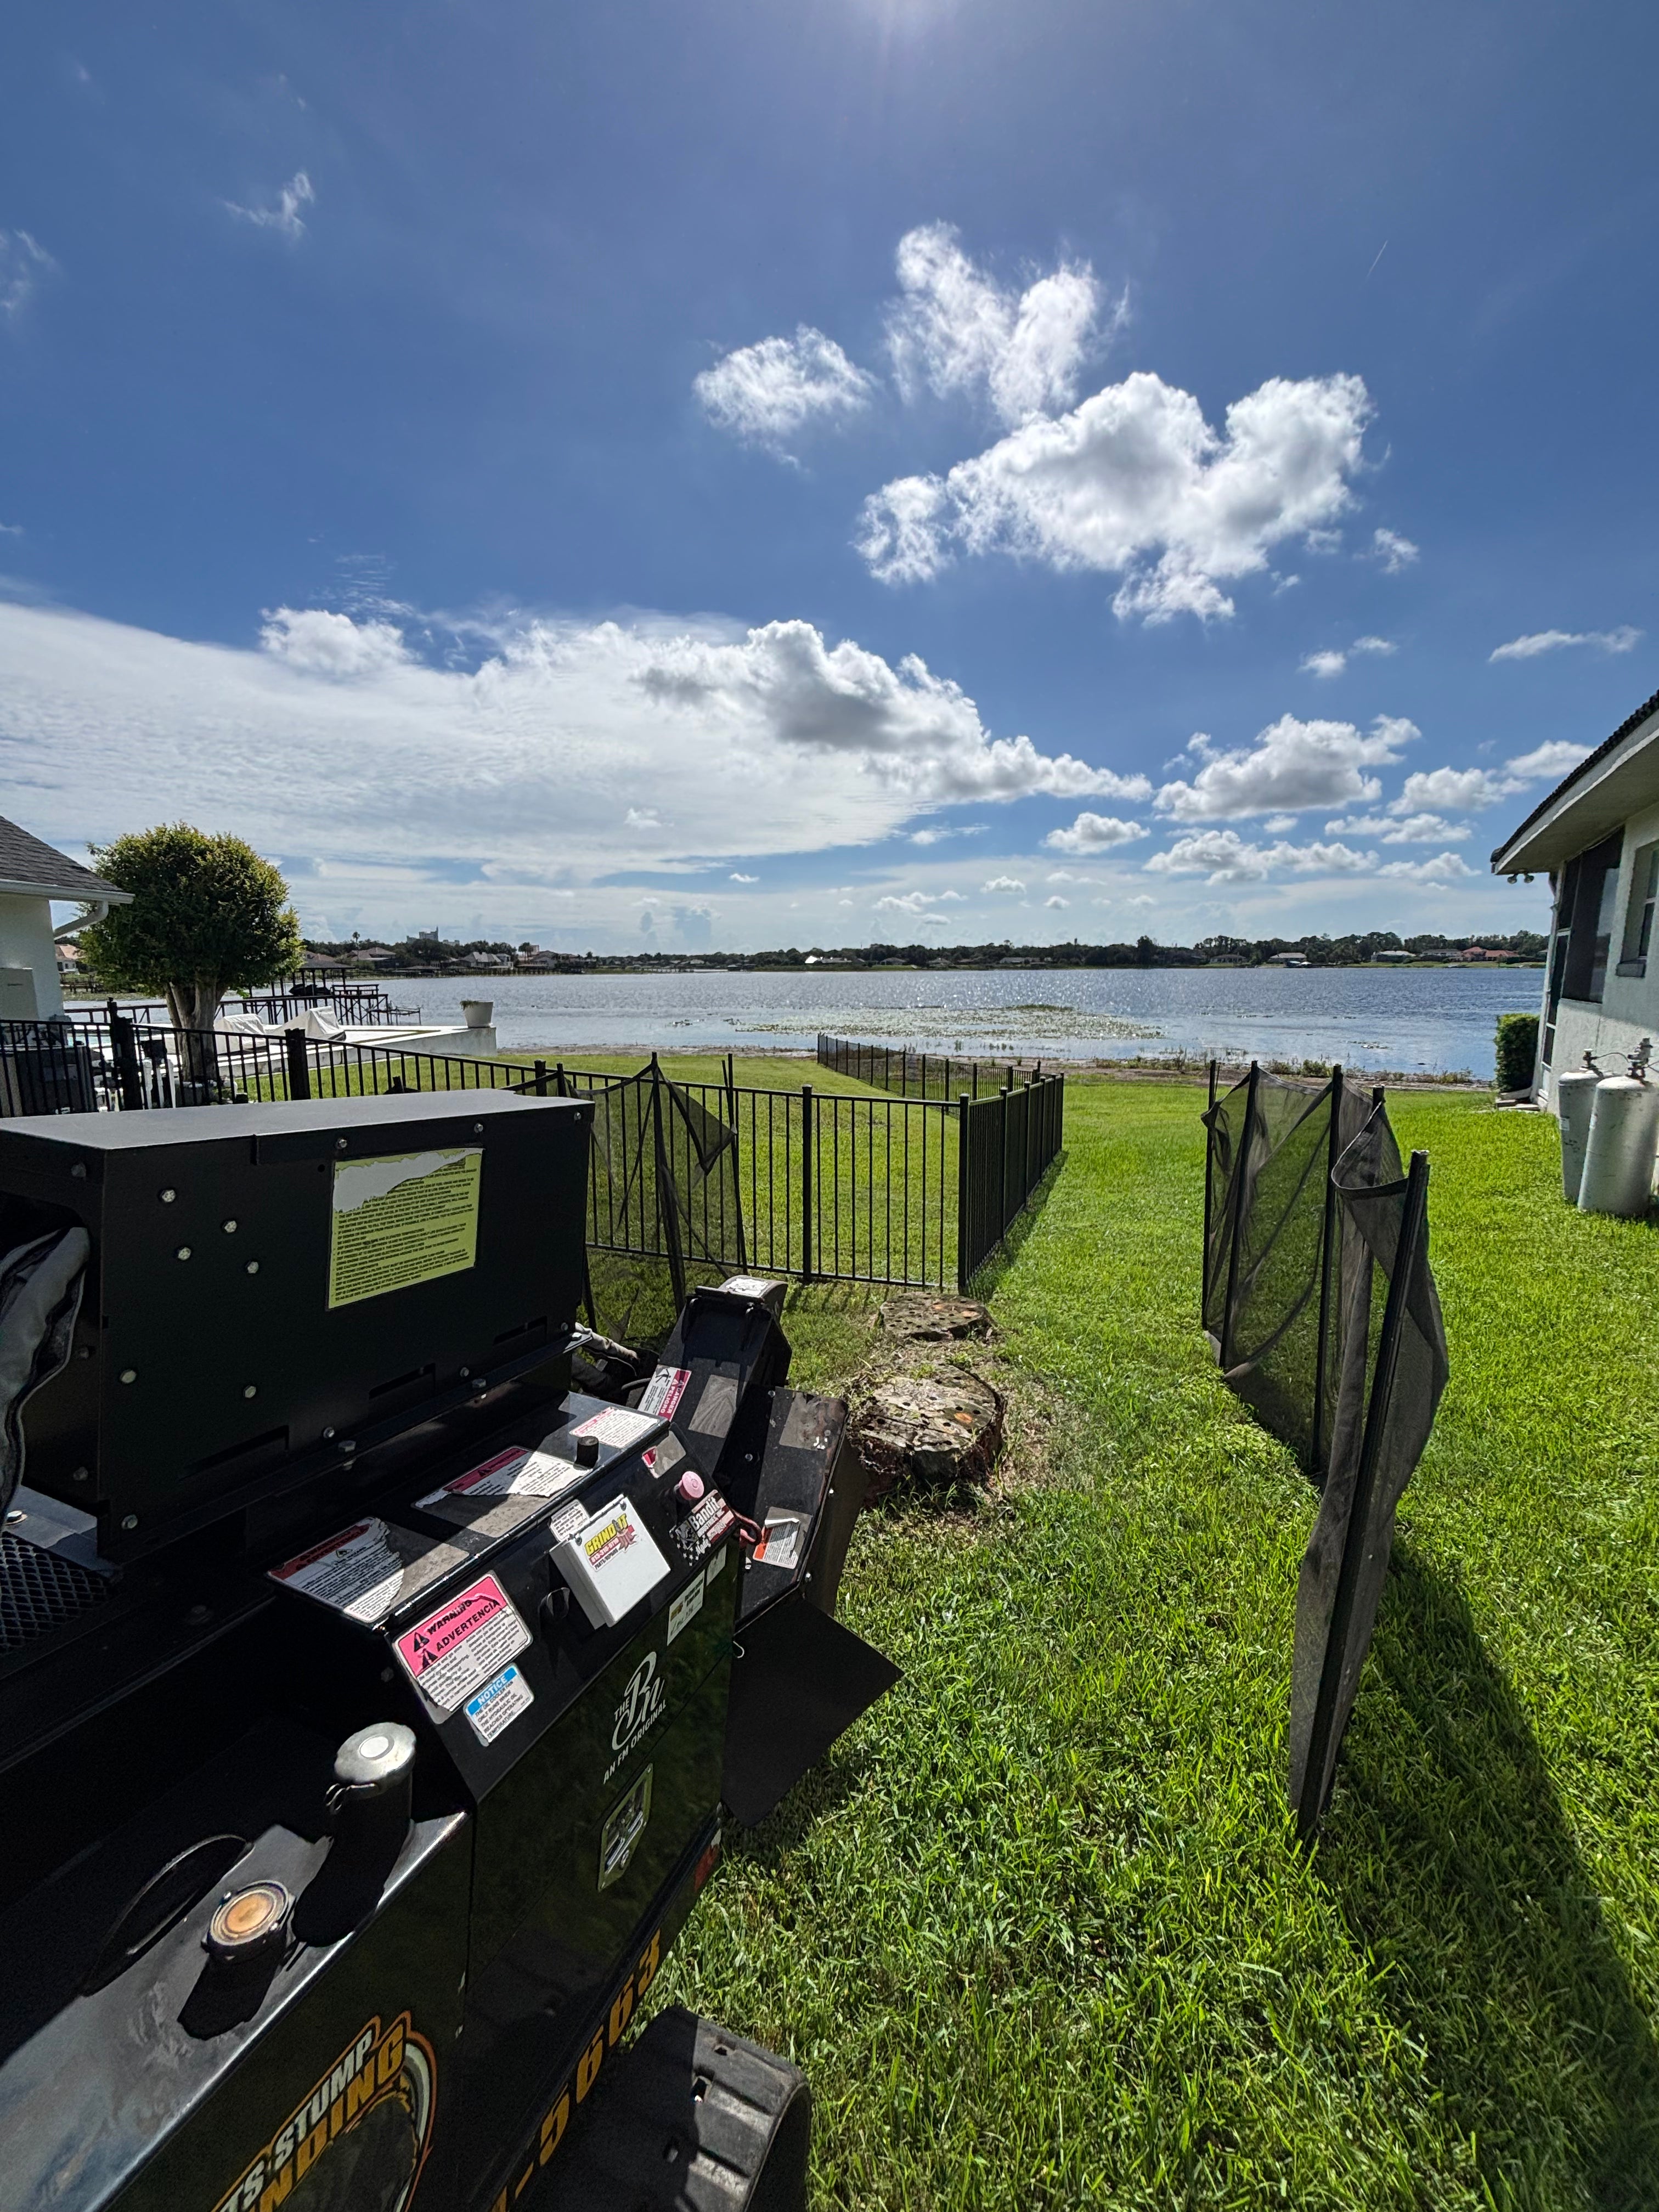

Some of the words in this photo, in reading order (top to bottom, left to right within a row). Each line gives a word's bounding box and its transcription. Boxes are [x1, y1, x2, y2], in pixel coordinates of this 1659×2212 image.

[660, 1386, 675, 1414] PELIGRO
[667, 1387, 681, 1414] DANGER
[687, 1495, 721, 1532] Bandit
[585, 1523, 617, 1556] GRIND
[427, 1599, 473, 1634] WARNING
[436, 1600, 501, 1651] ADVERTENCIA
[476, 1675, 507, 1705] NOTICE
[614, 1695, 629, 1723] THE
[603, 1760, 615, 1785] AN
[618, 1743, 628, 1767] FM
[631, 1699, 666, 1750] ORIGINAL
[250, 2023, 404, 2211] NDING
[274, 2030, 373, 2170] STUMP
